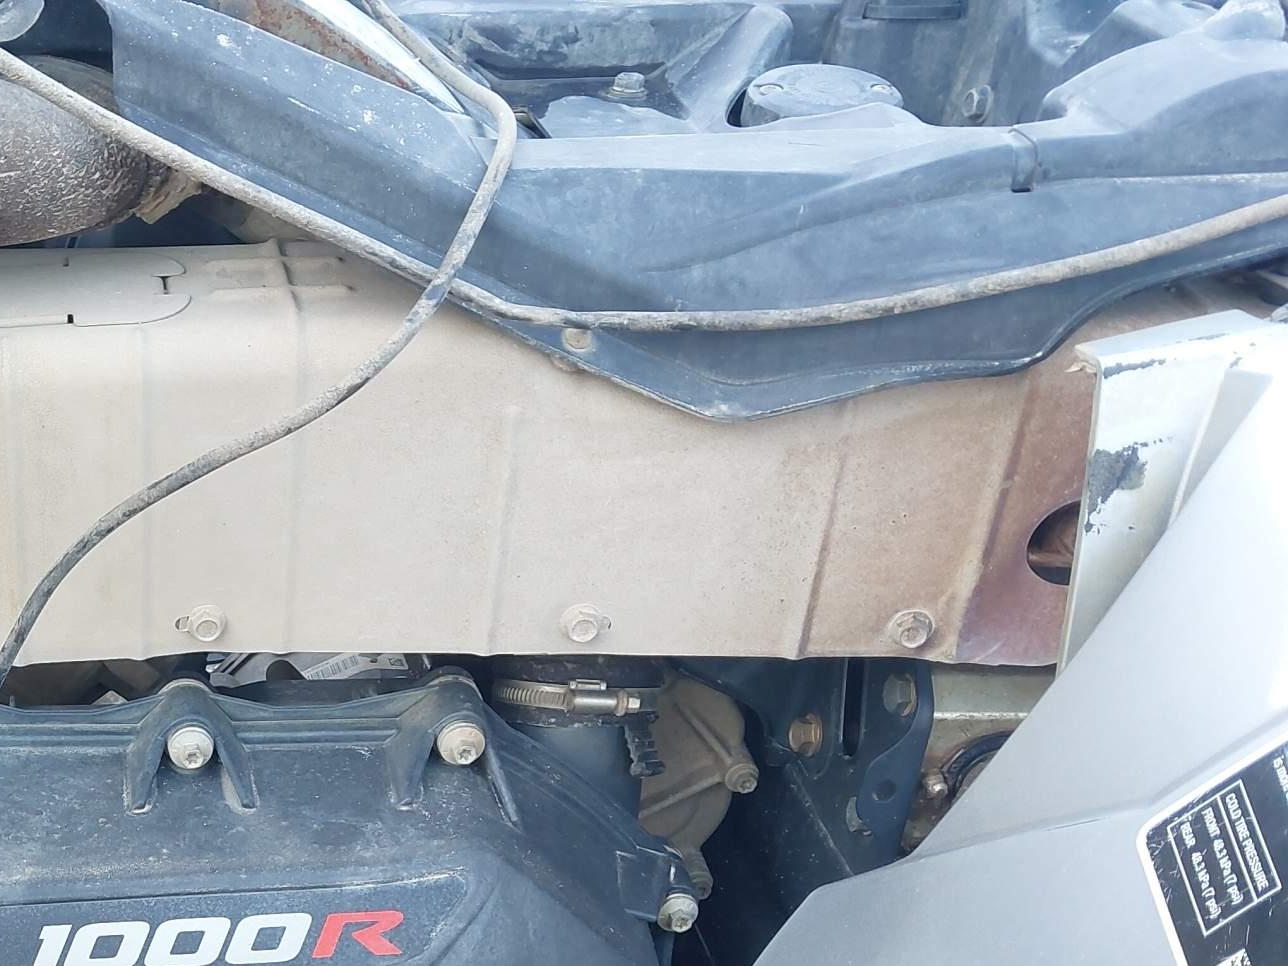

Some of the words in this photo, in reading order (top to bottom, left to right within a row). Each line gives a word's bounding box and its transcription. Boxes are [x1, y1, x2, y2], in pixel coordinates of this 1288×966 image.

[1180, 822, 1196, 849] REAR
[1201, 807, 1220, 837] FRONT
[1225, 793, 1242, 820] COLD
[1234, 817, 1250, 842] TIRE
[1243, 838, 1269, 893] PRESSURE
